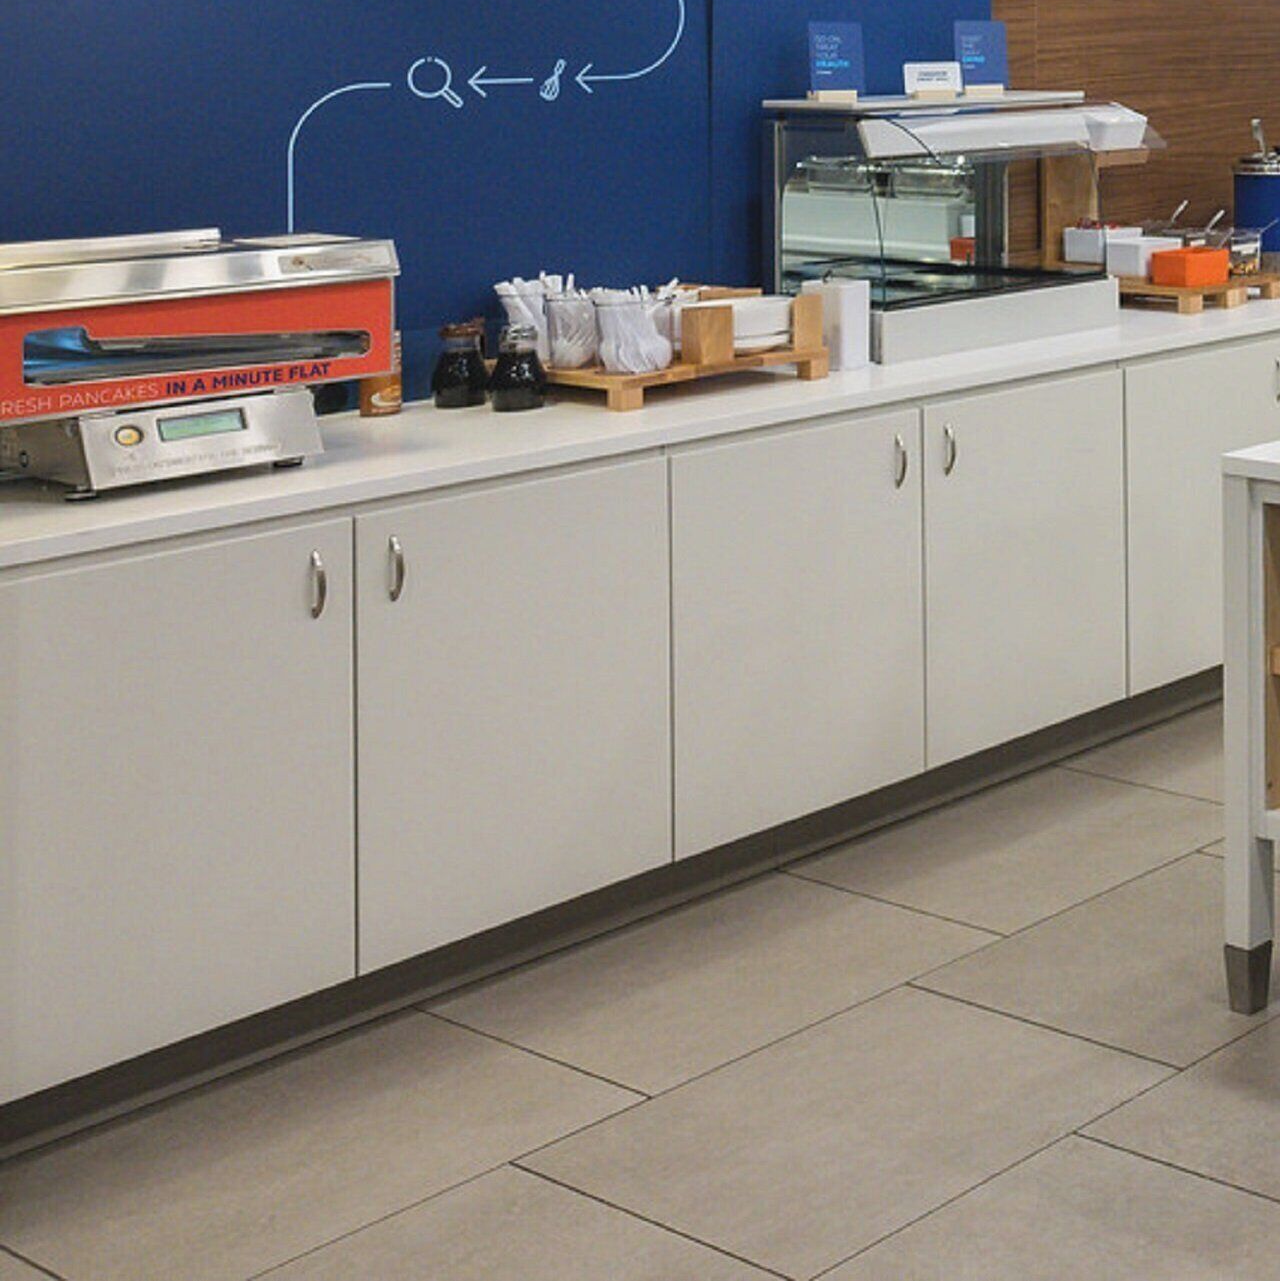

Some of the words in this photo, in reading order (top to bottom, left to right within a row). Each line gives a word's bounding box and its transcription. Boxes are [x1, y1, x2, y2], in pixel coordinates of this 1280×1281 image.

[0, 392, 51, 416] RESH
[59, 381, 159, 409] PANCAKES
[166, 380, 187, 395] IN
[192, 378, 208, 393] A
[212, 369, 283, 391] MINUTE
[289, 362, 332, 380] FLAT
